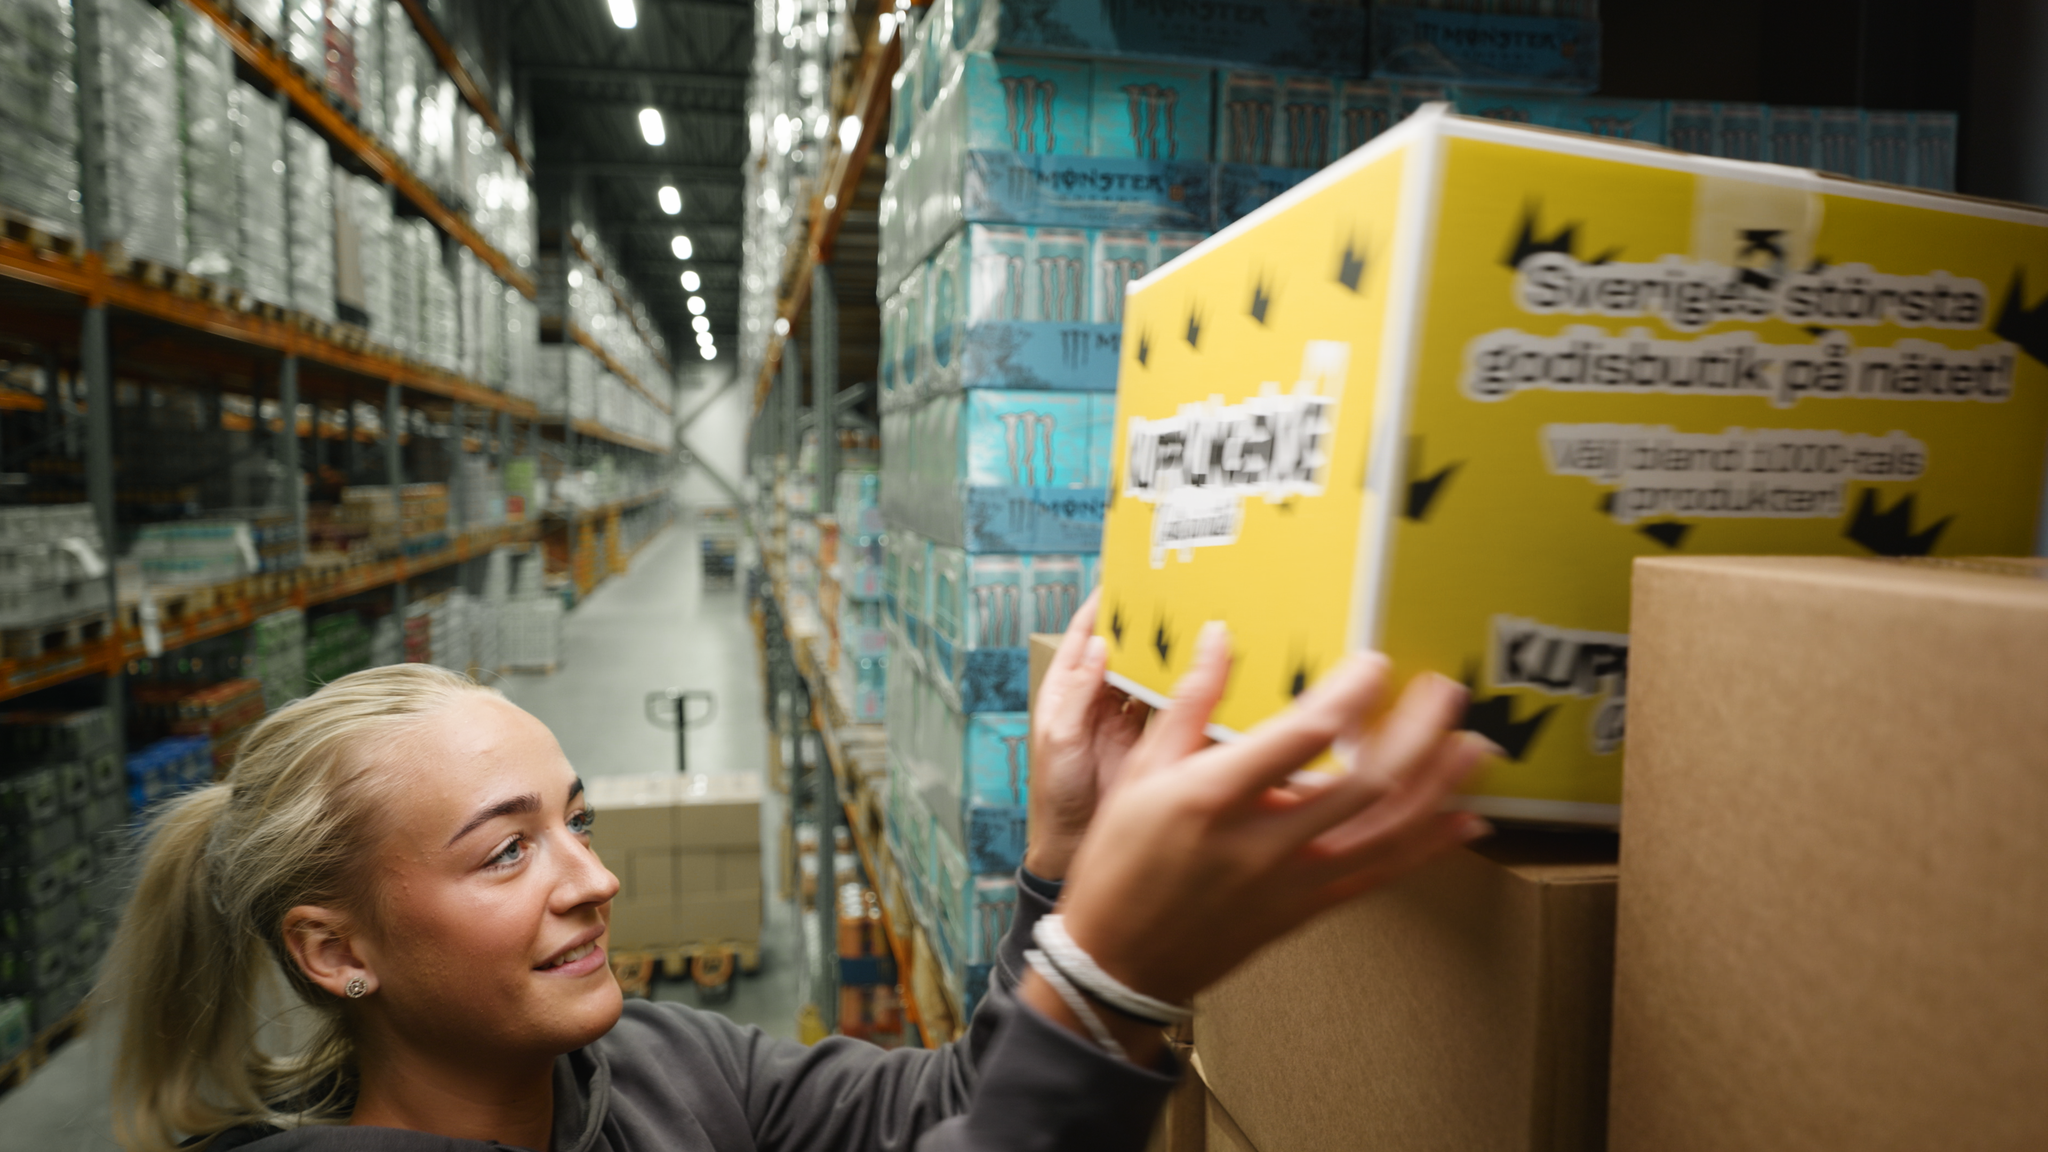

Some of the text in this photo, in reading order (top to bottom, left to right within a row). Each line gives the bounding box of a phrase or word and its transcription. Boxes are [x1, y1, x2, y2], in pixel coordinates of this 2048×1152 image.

[1036, 168, 1165, 196] MONSTER
[1522, 262, 1985, 326] Sveriges största
[1471, 338, 2015, 403] godisbutik på nätet!
[1547, 436, 1925, 480] Välj bland 1000-tals
[1615, 480, 1846, 520] produkter!
